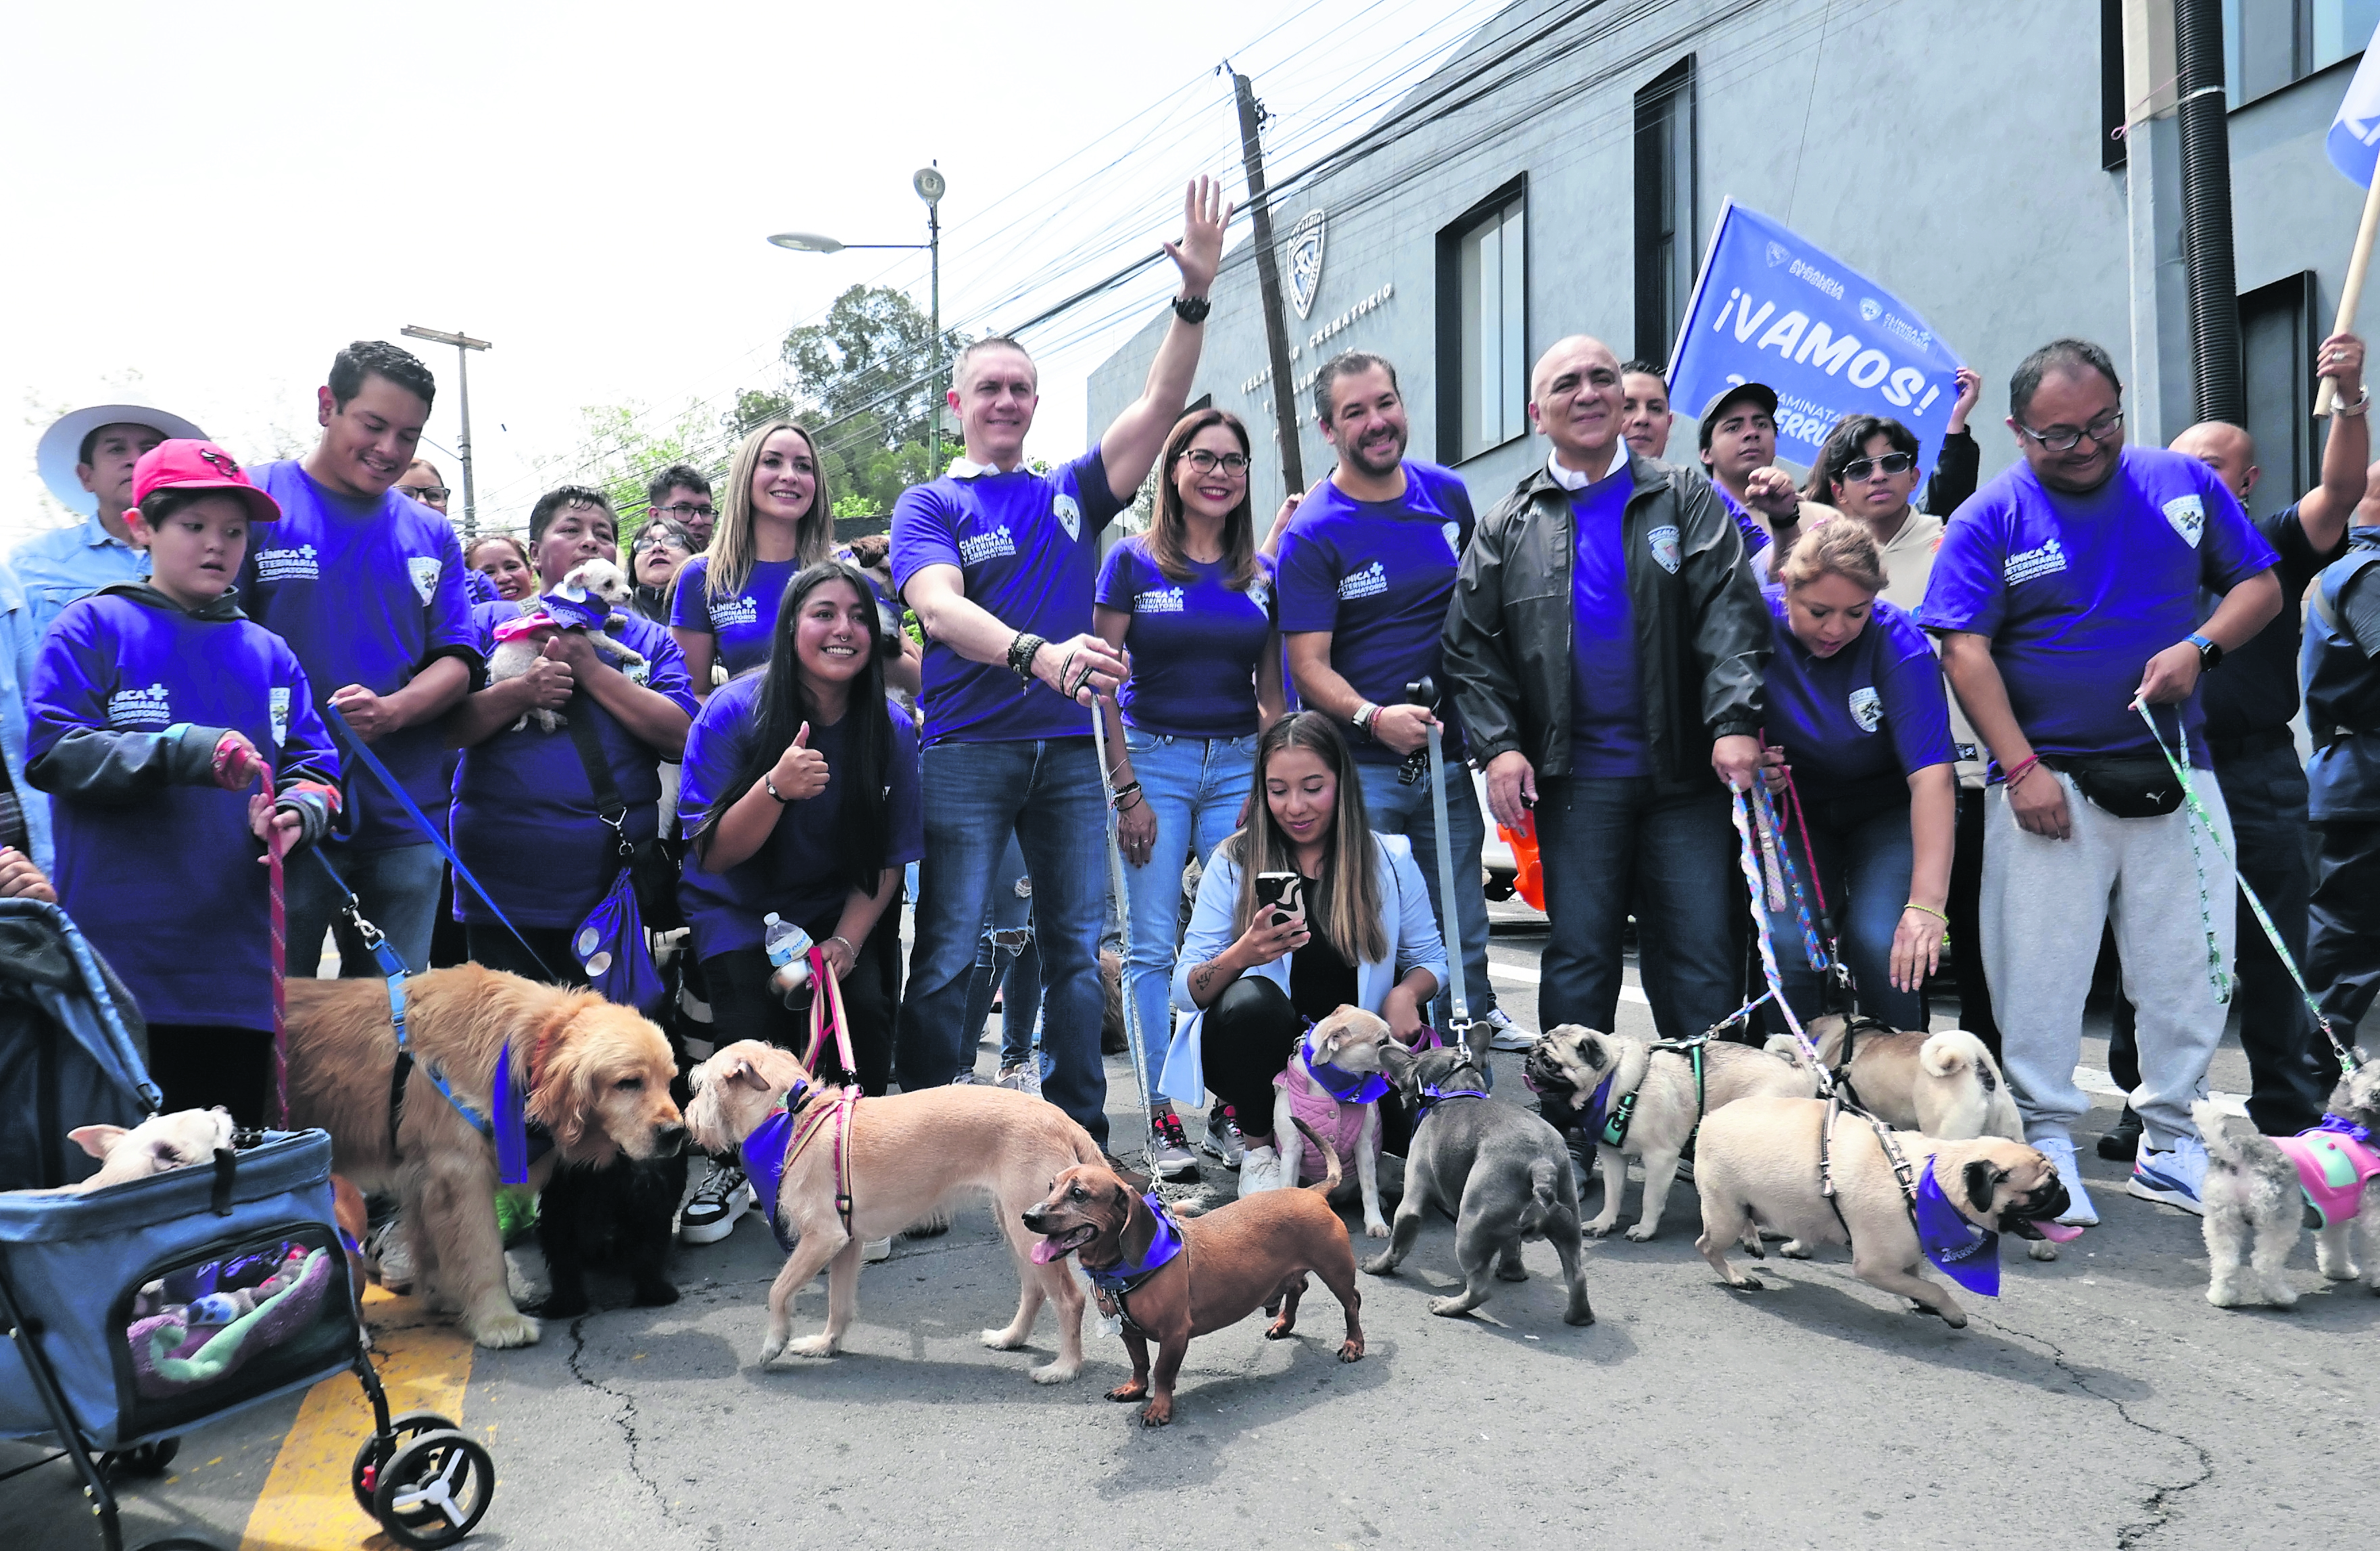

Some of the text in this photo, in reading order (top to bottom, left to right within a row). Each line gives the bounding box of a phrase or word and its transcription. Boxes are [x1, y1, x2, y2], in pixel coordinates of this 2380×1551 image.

[1309, 283, 1392, 349] CREMATORIO
[1713, 287, 1941, 416] ¡VAMOS!
[1774, 389, 1841, 423] AMINATA
[1773, 407, 1835, 447] ERRU
[961, 537, 1014, 557] VETERINARIA
[969, 545, 1015, 561] CREMATORIO
[2004, 548, 2045, 568] LÍNICA
[2009, 559, 2066, 581] CREMATORIO
[1342, 581, 1387, 598] CREMATORIO
[709, 607, 757, 622] VETERINARIA
